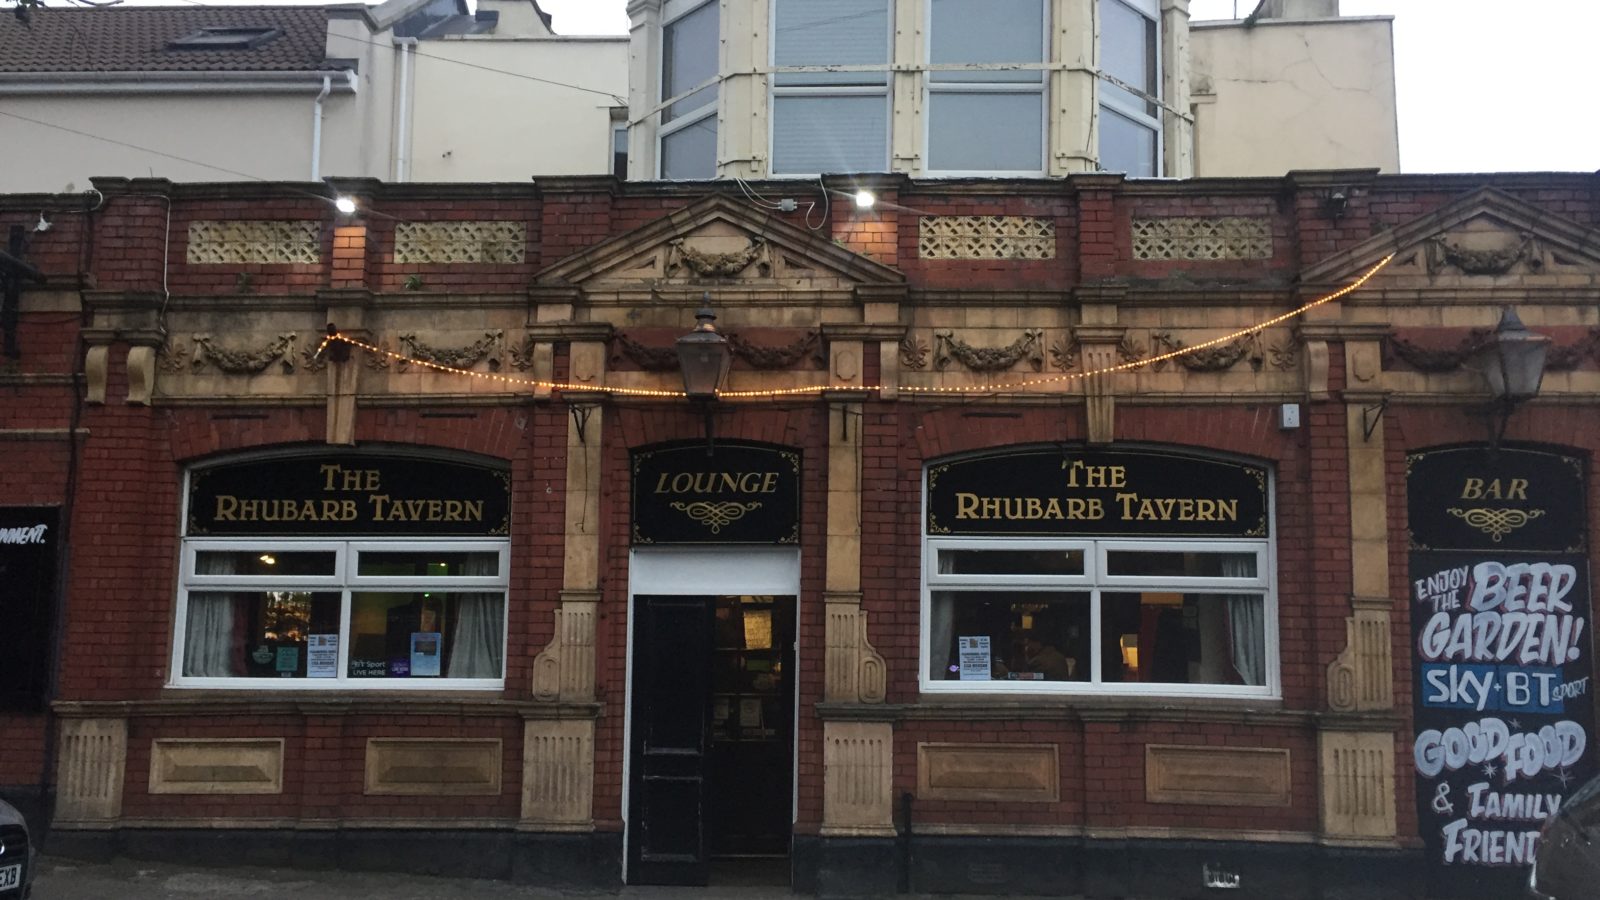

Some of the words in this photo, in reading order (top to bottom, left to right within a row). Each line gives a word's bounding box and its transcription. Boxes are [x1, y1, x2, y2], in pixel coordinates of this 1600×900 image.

[320, 464, 381, 491] THE
[654, 472, 779, 493] LOUNGE
[1062, 460, 1126, 488] THE
[1460, 478, 1529, 500] BAR
[214, 495, 358, 521] RHUBARB
[368, 494, 484, 521] TAVERN
[955, 492, 1104, 520] RHUBARB
[1115, 492, 1239, 521] TAVERN
[1415, 565, 1469, 600] ENJOY
[1470, 561, 1577, 612] BEER
[1430, 590, 1462, 611] THE
[1422, 611, 1584, 665] GARDEN!
[1506, 671, 1557, 706] BT
[1552, 676, 1589, 702] SPORT
[1414, 717, 1509, 776] GOOD
[1504, 720, 1586, 780] FOOD
[1433, 780, 1454, 814] &
[1468, 782, 1562, 819] FAMILY
